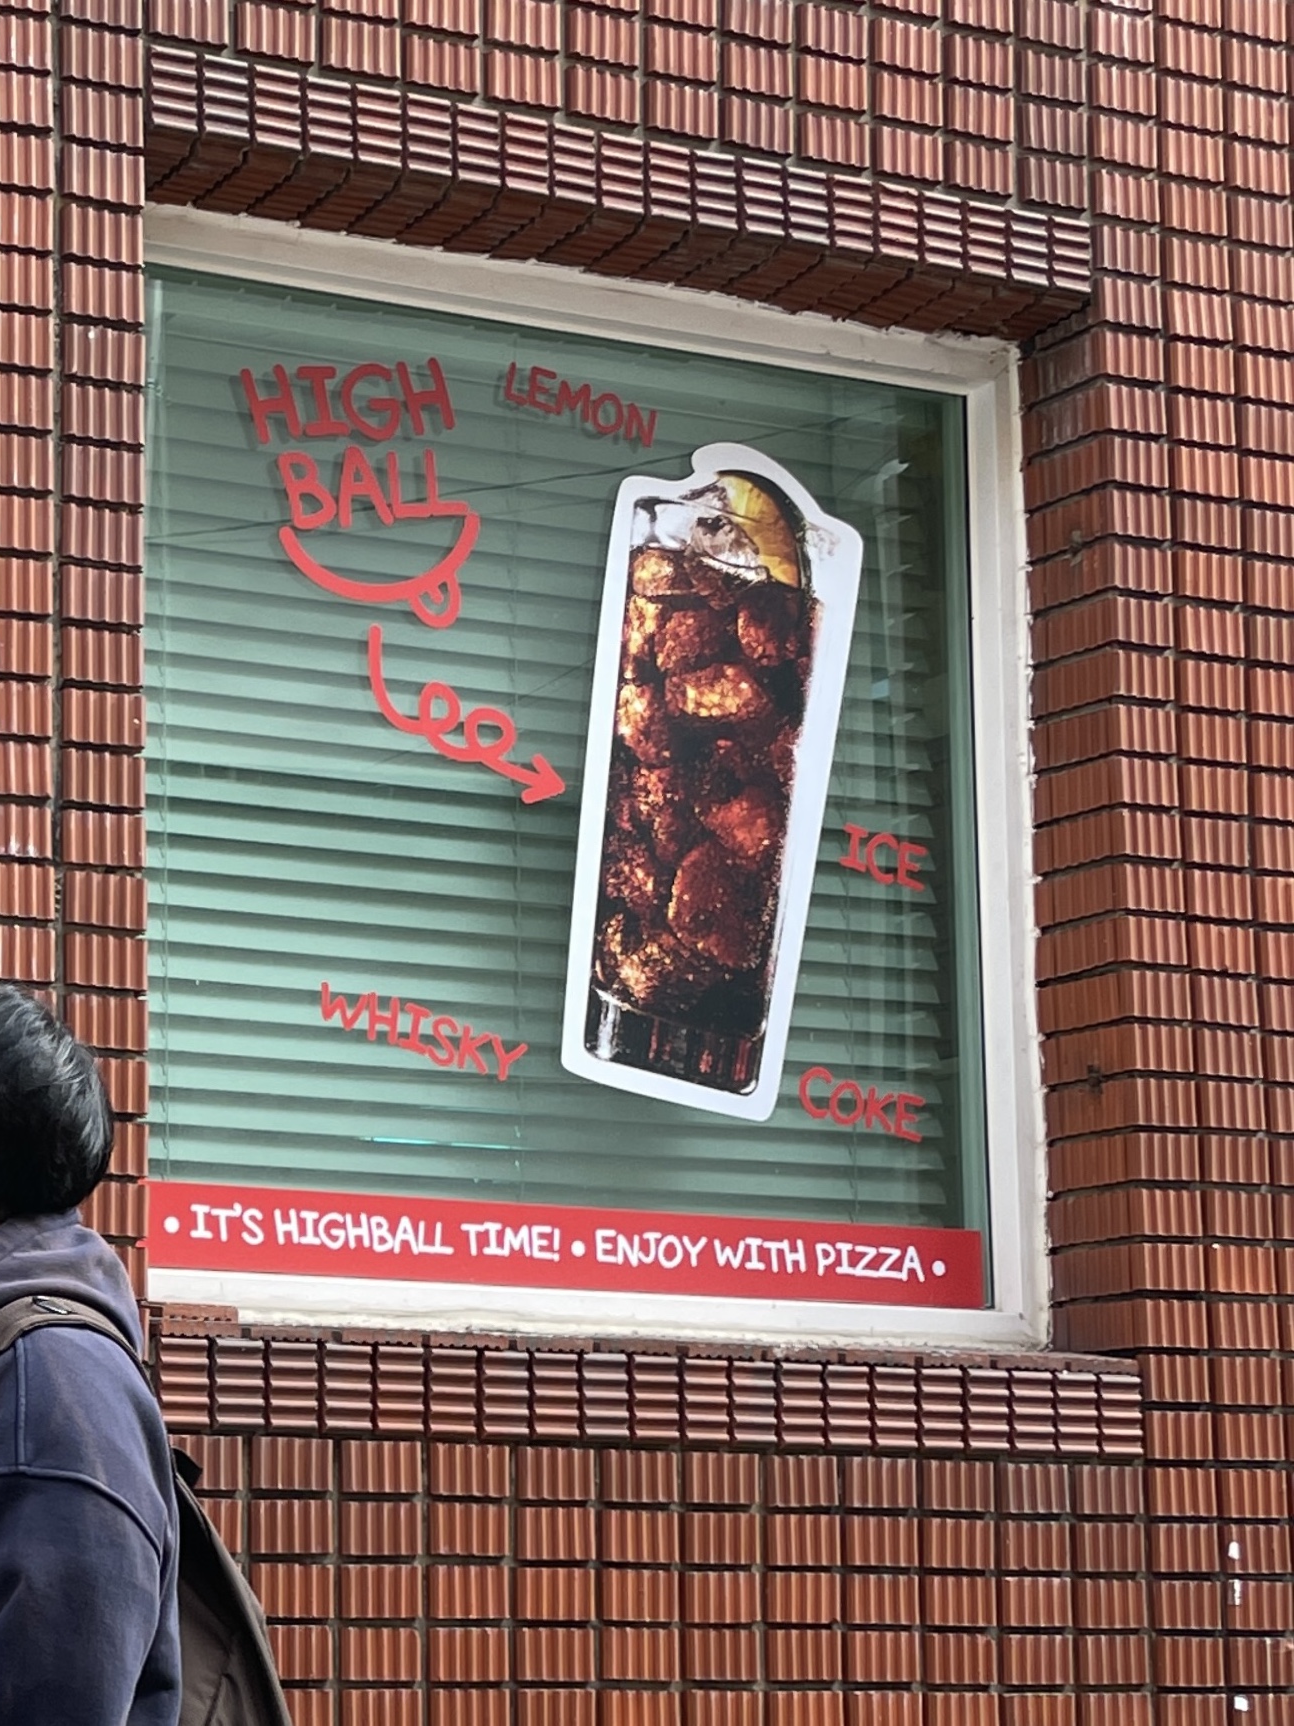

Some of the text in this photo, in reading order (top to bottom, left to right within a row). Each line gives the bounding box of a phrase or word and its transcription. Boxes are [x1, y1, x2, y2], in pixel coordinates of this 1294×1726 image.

[240, 358, 456, 444] HIGH
[505, 362, 657, 447] LEMON
[277, 446, 469, 530] BALL
[839, 823, 928, 892] ICE
[319, 981, 529, 1082] WHISKY
[798, 1066, 925, 1143] COKE
[190, 1202, 926, 1283] IT'S HIGHBALL TIME! ENJOY WITH PIZZA
